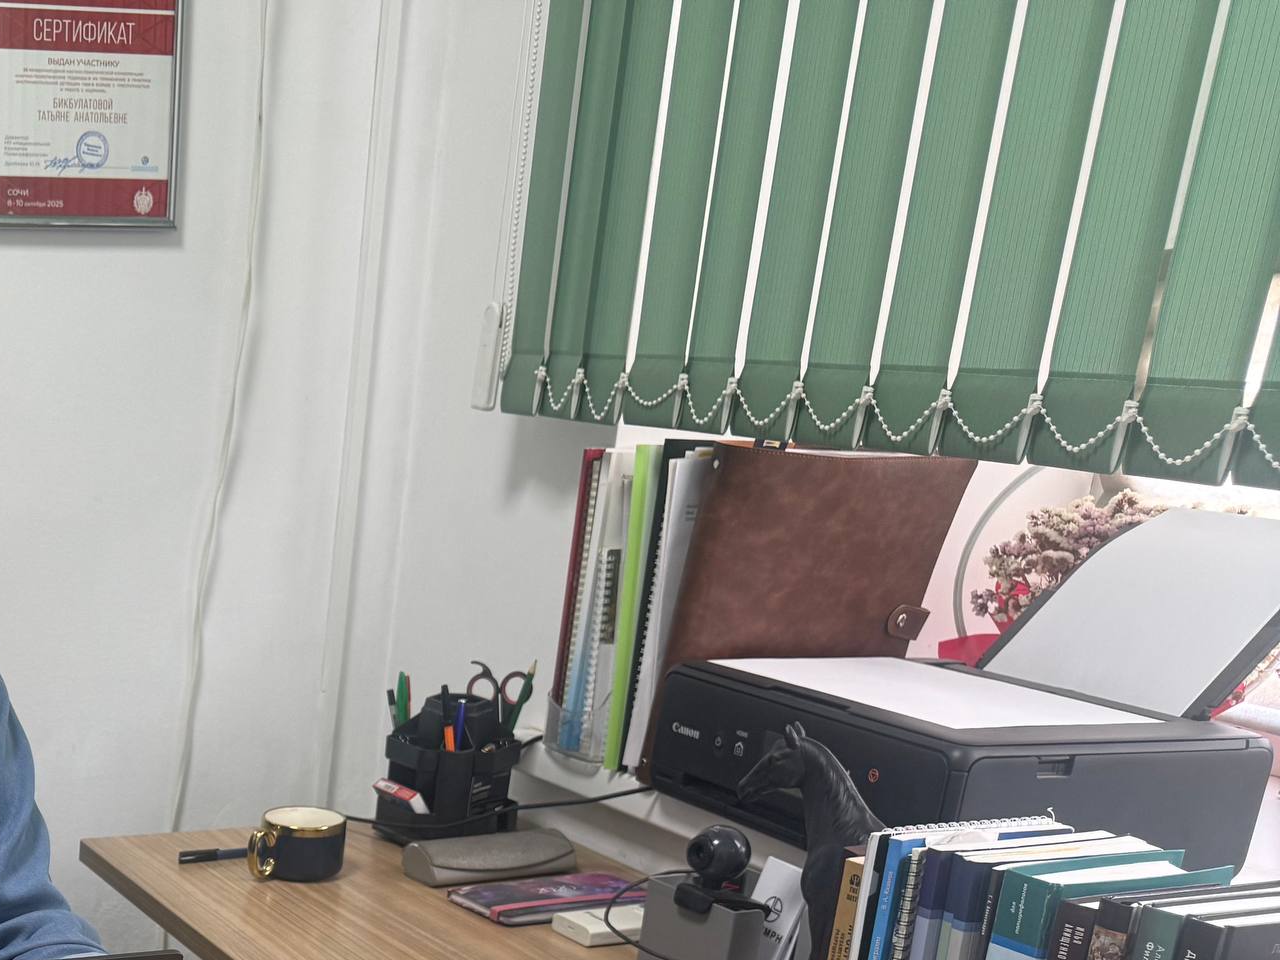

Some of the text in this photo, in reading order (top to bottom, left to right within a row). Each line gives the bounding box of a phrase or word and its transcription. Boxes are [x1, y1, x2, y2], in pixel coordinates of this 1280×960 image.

[33, 18, 135, 45] СЕРТИФИКАТ
[48, 57, 120, 68] ВЫДАН УЧАСТНИКУ
[53, 97, 113, 110] БИКБУЛАТОВОЙ
[37, 110, 128, 125] ТАТЬЯНЕ АНАТОЛЬЕВНЕ
[7, 188, 30, 197] СОЧИ
[672, 722, 700, 740] Canon
